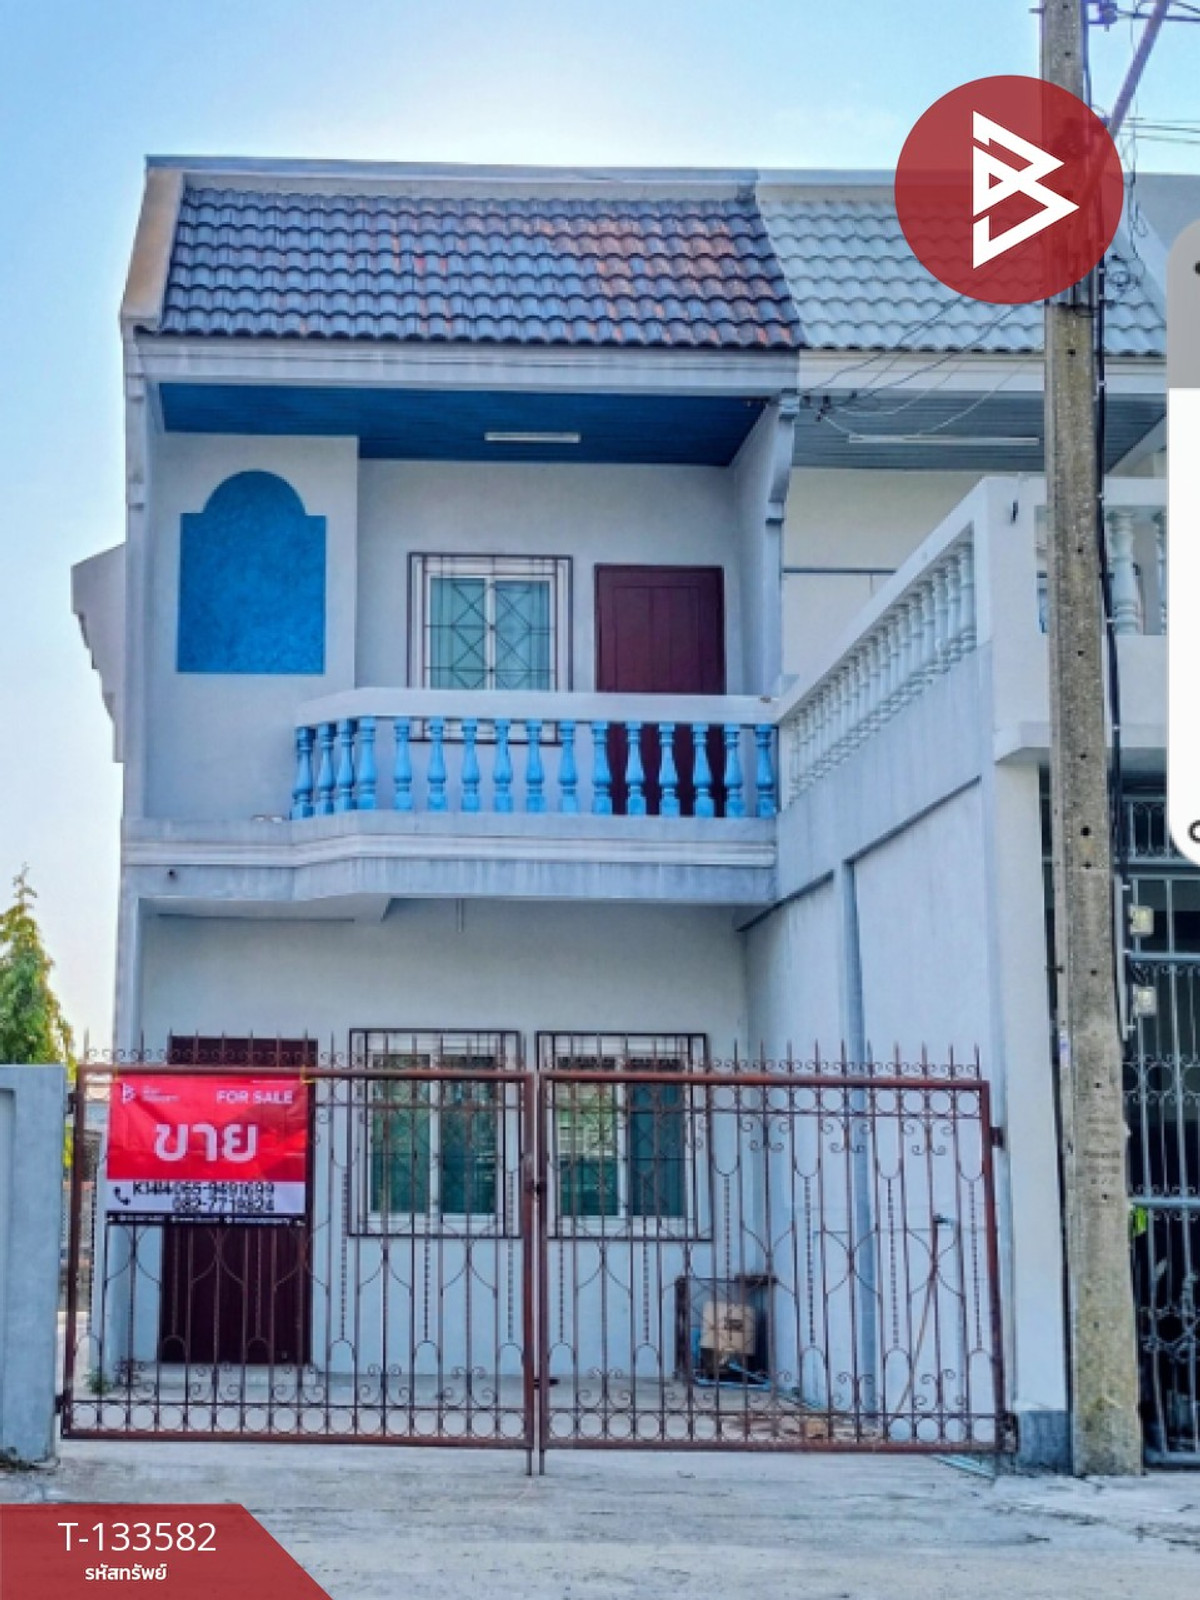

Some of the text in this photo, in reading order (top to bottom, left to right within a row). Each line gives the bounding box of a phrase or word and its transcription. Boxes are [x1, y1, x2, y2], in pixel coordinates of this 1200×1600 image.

[216, 1089, 293, 1104] FOR SALE
[155, 1122, 257, 1163] ขาย
